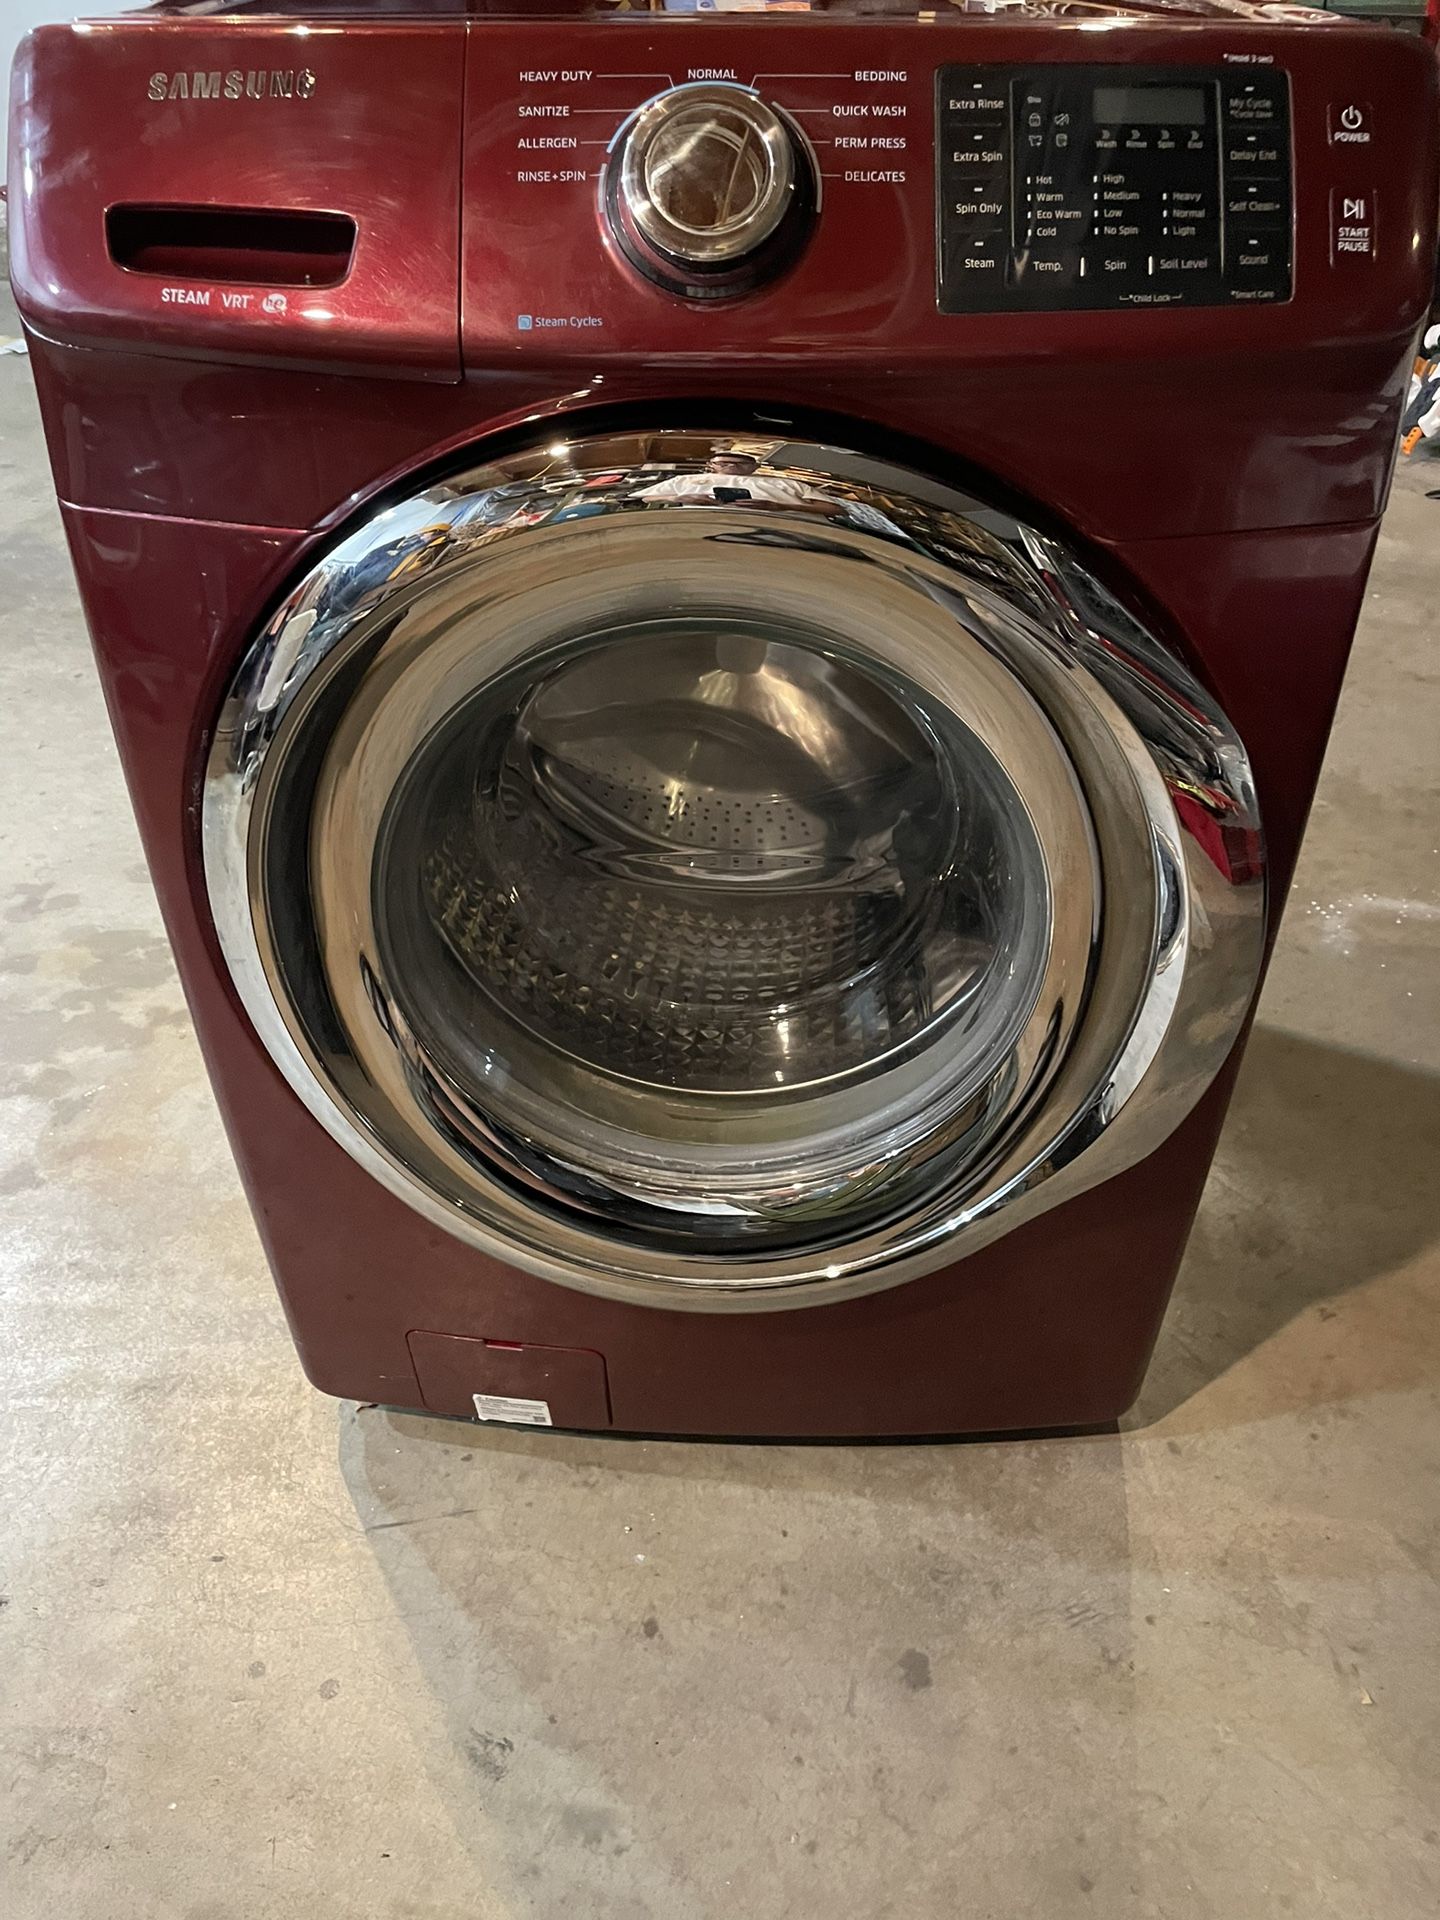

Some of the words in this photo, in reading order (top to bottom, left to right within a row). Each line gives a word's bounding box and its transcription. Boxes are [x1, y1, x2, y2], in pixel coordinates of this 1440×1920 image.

[520, 71, 558, 82] HEAVY
[561, 71, 593, 81] DUTY
[688, 69, 737, 80] NORMAL
[854, 71, 907, 82] BEDDING
[147, 69, 318, 100] SAMSUNG
[949, 100, 975, 110] Extra
[978, 100, 1004, 109] Rinse
[518, 105, 569, 117] SANITIZE
[832, 105, 869, 117] QUICK
[872, 105, 907, 116] WASH
[1334, 132, 1370, 142] POWER
[518, 137, 577, 149] ALLERGEN
[835, 138, 867, 149] PERM
[871, 138, 906, 149] PRESS
[953, 152, 979, 162] Extra
[982, 152, 1003, 163] Spin
[1230, 150, 1256, 161] Delay
[1259, 151, 1276, 160] End
[517, 171, 586, 182] RINSE+SPIN
[845, 171, 906, 183] DELICATES
[1036, 175, 1052, 184] Hot
[1103, 174, 1125, 184] High
[1036, 193, 1064, 201] Warm
[1103, 191, 1139, 201] Medium
[1173, 191, 1202, 202] Heavy
[956, 204, 978, 215] Spin
[980, 204, 1002, 215] Only
[1037, 210, 1053, 219] Eco
[1055, 210, 1082, 219] Warm
[1103, 209, 1123, 218] Low
[1173, 208, 1206, 218] Normal
[1037, 227, 1057, 236] Cold
[1104, 226, 1118, 235] No
[1120, 226, 1139, 236] Spin
[1173, 226, 1195, 236] Light
[1338, 228, 1370, 237] START
[1338, 242, 1369, 251] PAUSE
[964, 259, 994, 268] Steam
[1160, 259, 1179, 268] Soil
[1181, 259, 1207, 268] Level
[1240, 255, 1269, 264] Sound
[1034, 261, 1063, 272] Temp.
[1105, 260, 1127, 271] Spin
[162, 288, 210, 305] STEAM
[535, 317, 567, 327] Steam
[570, 316, 603, 328] Cycles
